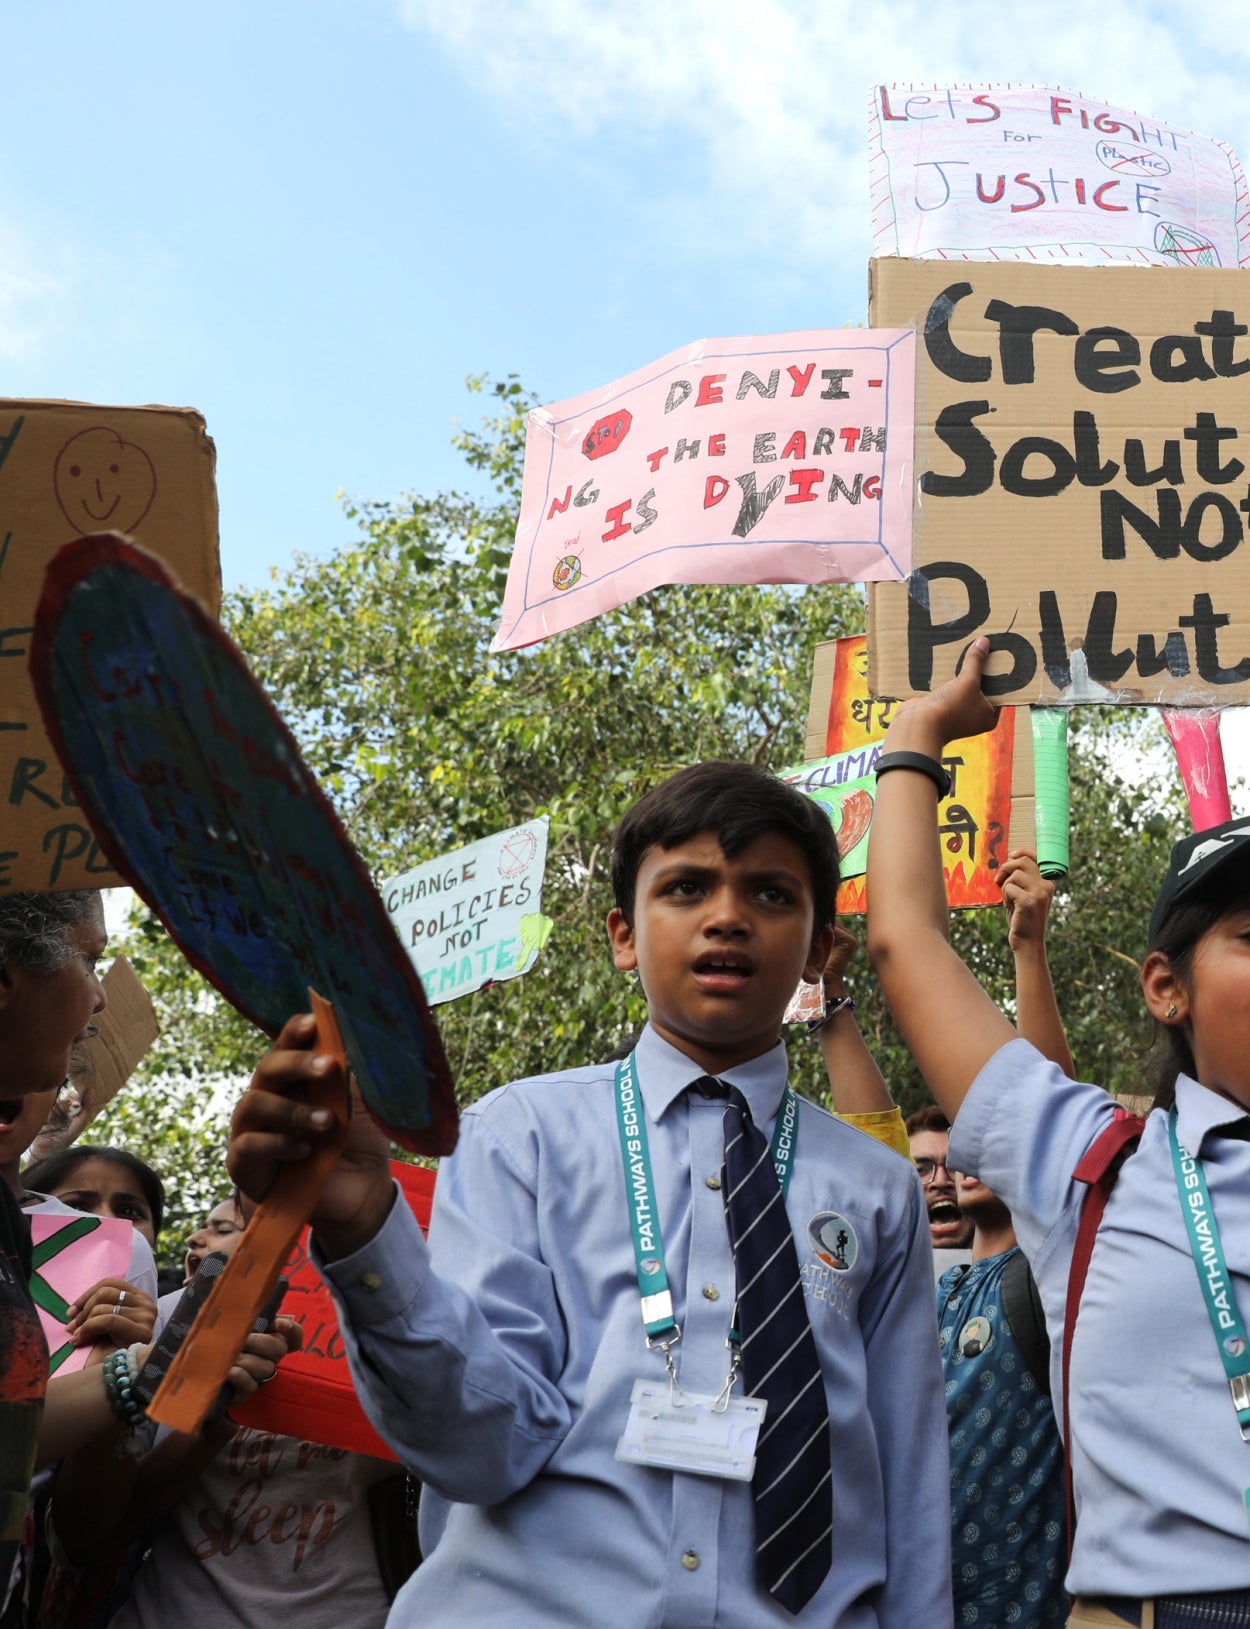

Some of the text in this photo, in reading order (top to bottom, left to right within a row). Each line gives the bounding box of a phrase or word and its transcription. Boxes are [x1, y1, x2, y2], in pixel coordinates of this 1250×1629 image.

[646, 426, 888, 472] THE EARTH
[547, 478, 600, 520] NG
[601, 468, 882, 543] IS DYING
[805, 745, 885, 793] CLIMA
[387, 859, 477, 914] CHANGE
[411, 875, 532, 947] POLICIES
[420, 937, 517, 999] IMATE
[439, 918, 489, 958] NOT
[620, 1071, 640, 1137] SCHOOL
[776, 1098, 797, 1161] SCHOOL
[627, 1139, 656, 1252] PATHWAYS
[1188, 1191, 1236, 1329] PATHWAYS
[194, 1477, 349, 1572] sleep
